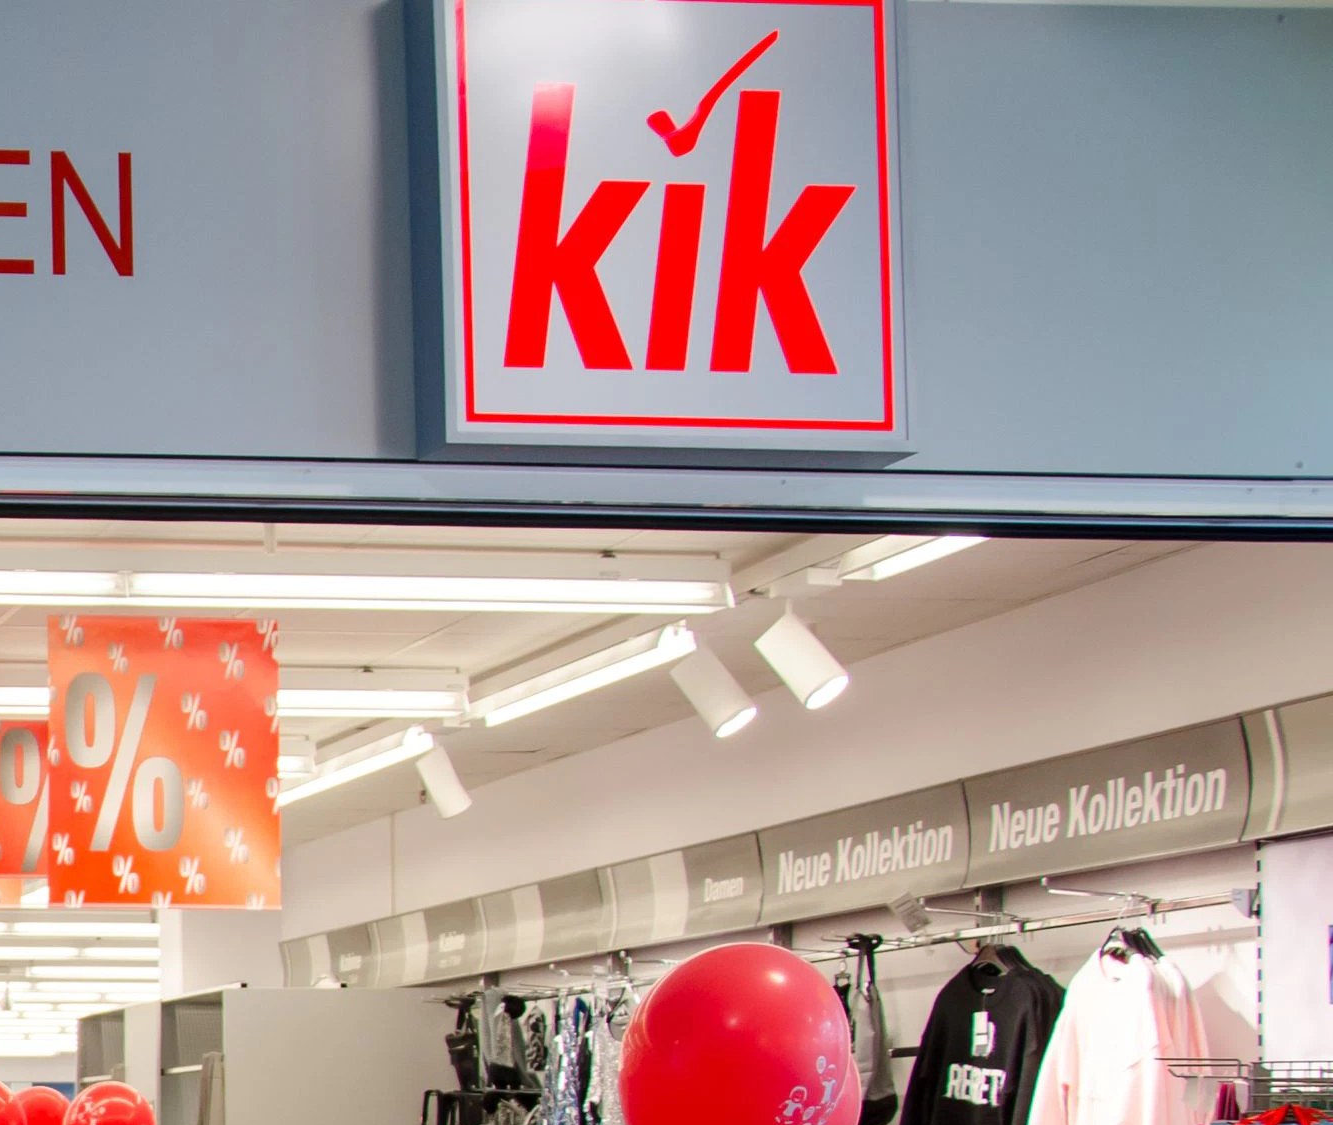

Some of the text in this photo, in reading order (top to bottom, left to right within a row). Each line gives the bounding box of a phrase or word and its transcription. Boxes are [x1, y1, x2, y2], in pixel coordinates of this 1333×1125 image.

[503, 29, 857, 375] kik
[988, 763, 1228, 854] Neue Kollektion
[703, 876, 744, 902] Damen
[777, 821, 954, 895] Neue Kollektion
